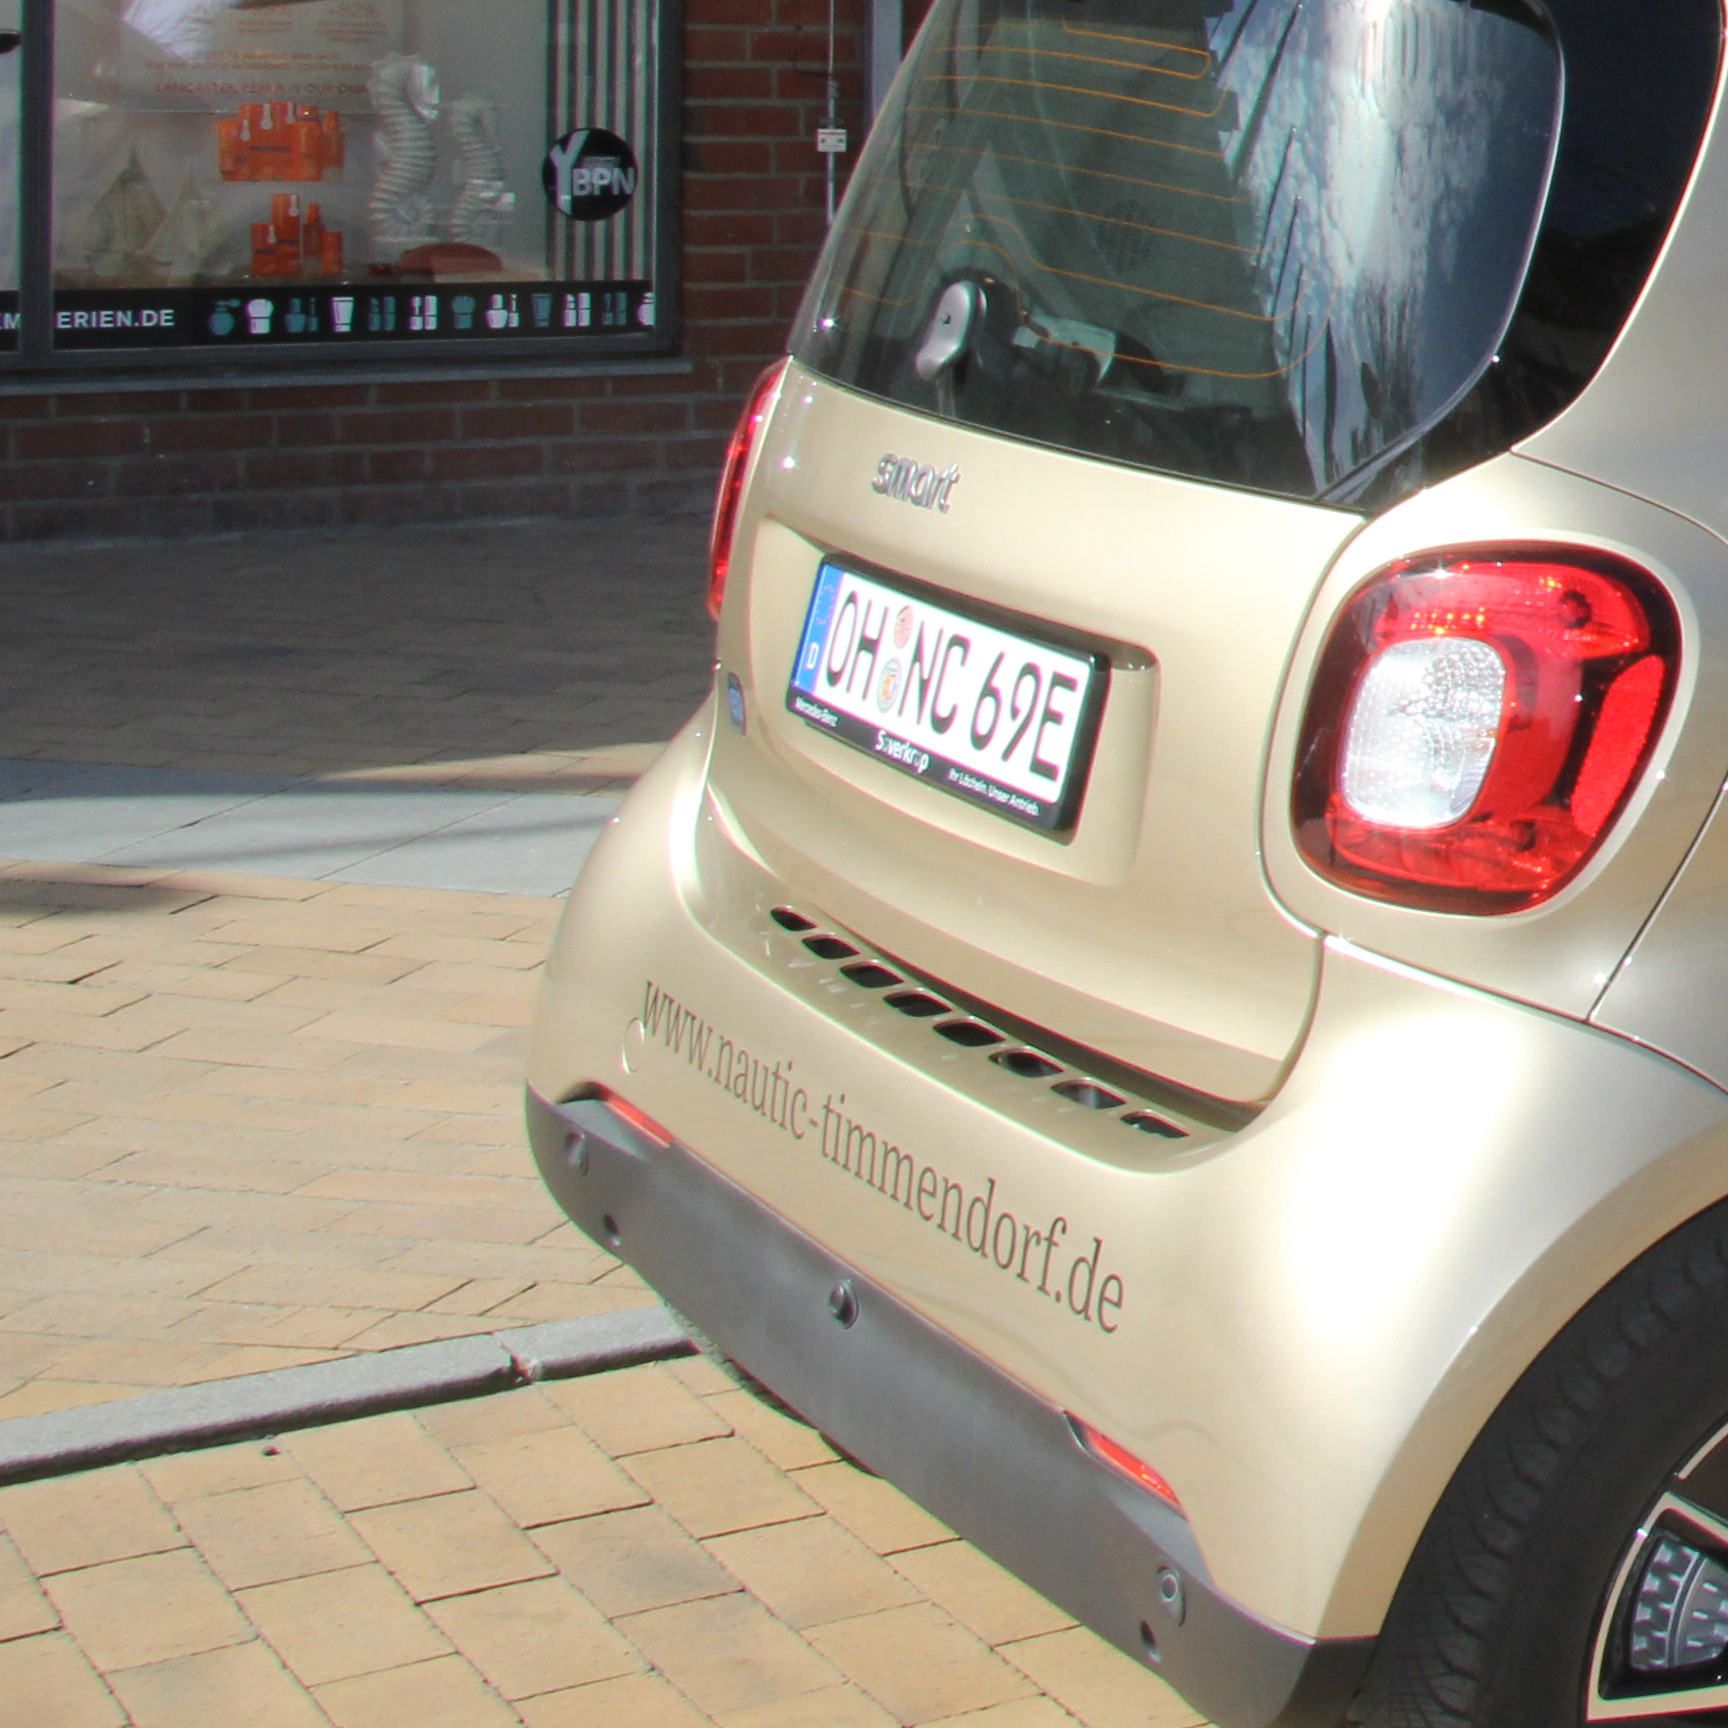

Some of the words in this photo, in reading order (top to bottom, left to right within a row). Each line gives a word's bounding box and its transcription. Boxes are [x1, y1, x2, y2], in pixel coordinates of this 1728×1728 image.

[56, 309, 175, 329] ERIEN.DE
[871, 452, 963, 514] smart
[806, 641, 820, 670] D
[826, 589, 890, 701] OH
[899, 619, 972, 735] NC
[968, 652, 1079, 782] 69E
[643, 980, 1125, 1335] www.nautic-timmendorf.de
